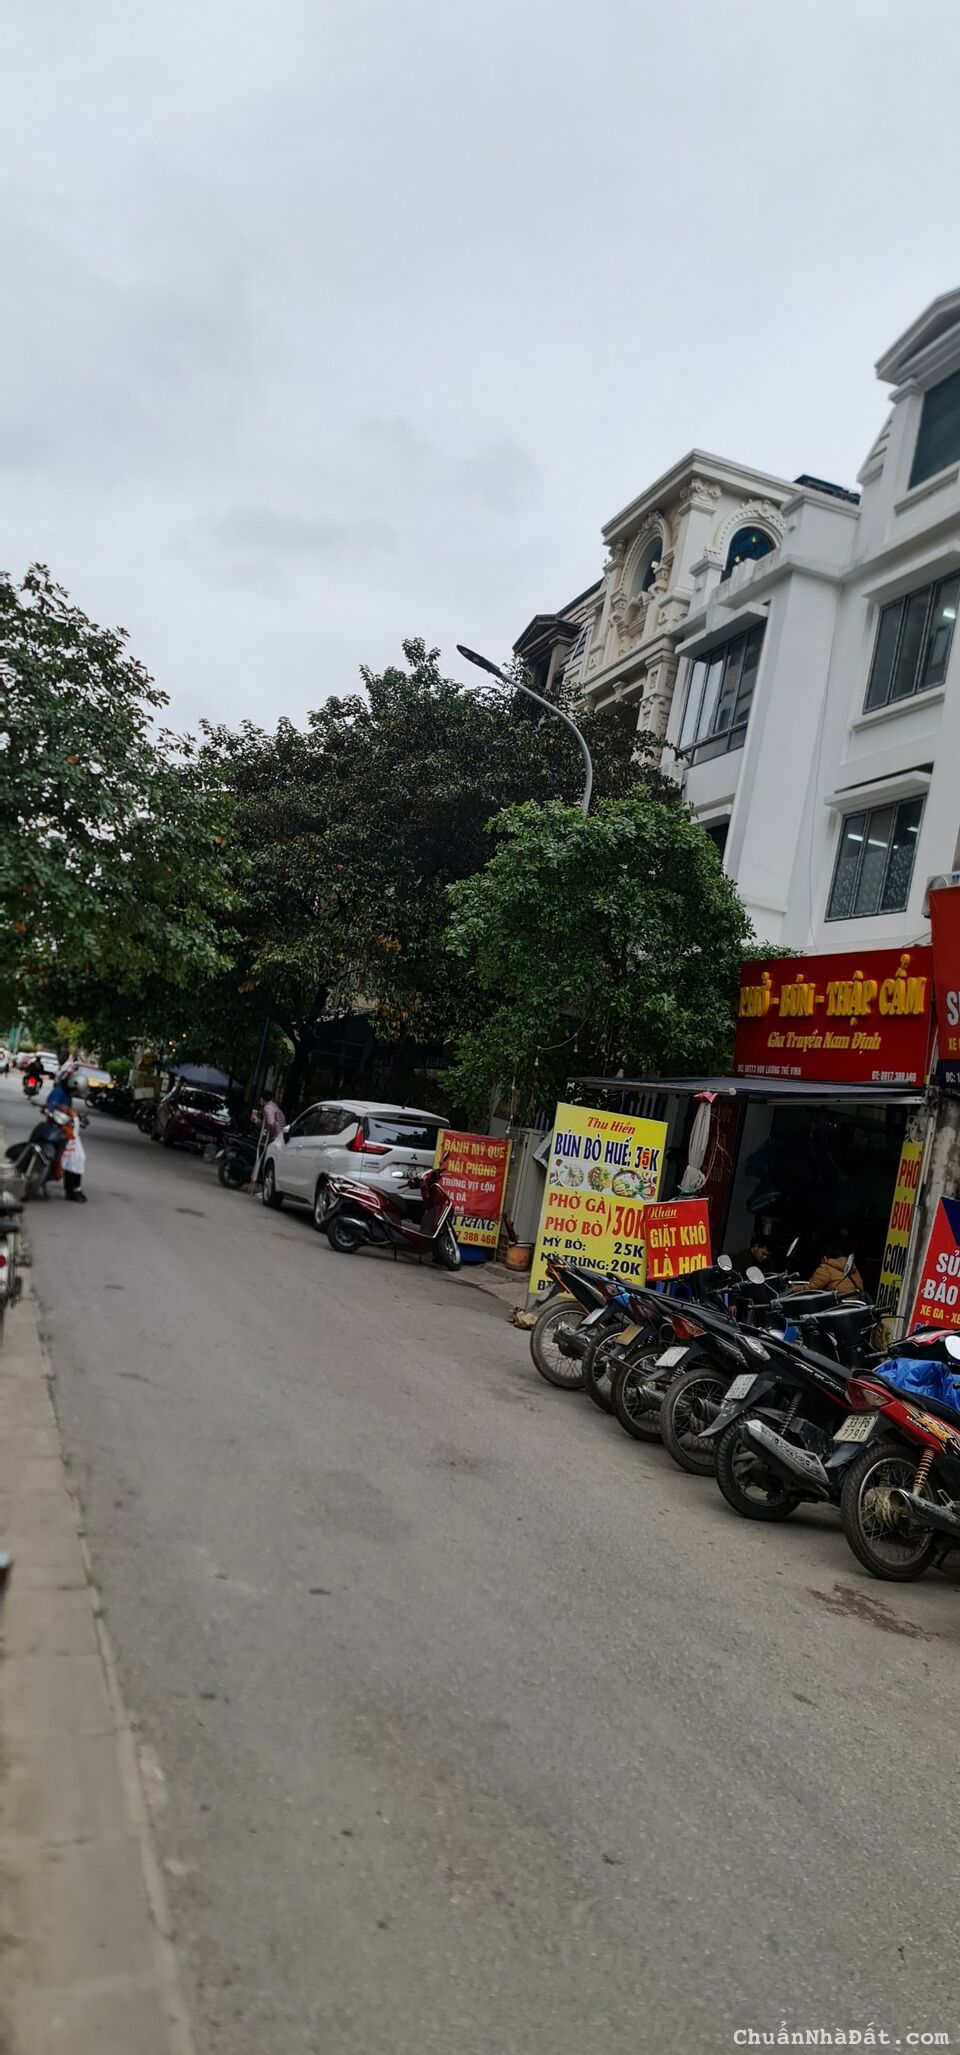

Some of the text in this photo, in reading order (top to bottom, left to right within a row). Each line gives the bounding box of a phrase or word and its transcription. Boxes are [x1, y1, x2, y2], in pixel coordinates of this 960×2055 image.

[826, 970, 877, 1026] THẬP
[879, 954, 927, 1016] CẨM
[767, 1029, 881, 1054] Gia Truyền Nam Định
[587, 1117, 636, 1135] Thu Hiền
[444, 1138, 469, 1154] BÁNH
[554, 1129, 582, 1158] BÚN
[583, 1134, 602, 1161] BÒ
[604, 1137, 632, 1167] HUẾ:
[898, 1151, 922, 1189] PHỞ
[467, 1180, 479, 1192] VỊT
[481, 1182, 496, 1193] LỘN
[548, 1191, 606, 1214] PHỞ GÀ
[891, 1196, 913, 1232] BÚN
[544, 1215, 578, 1233] PHỞ
[581, 1220, 603, 1237] BÒ
[650, 1221, 707, 1251] GIẶT KHÔ
[463, 1232, 479, 1241] 388
[481, 1234, 497, 1244] 468
[613, 1242, 645, 1258] 25K
[610, 1259, 642, 1275] 20K
[653, 1254, 708, 1277] LÀ HƠI
[936, 1250, 960, 1277] SỬ
[923, 1276, 958, 1306] BẢO
[920, 1304, 932, 1316] XE
[933, 1308, 944, 1320] GA
